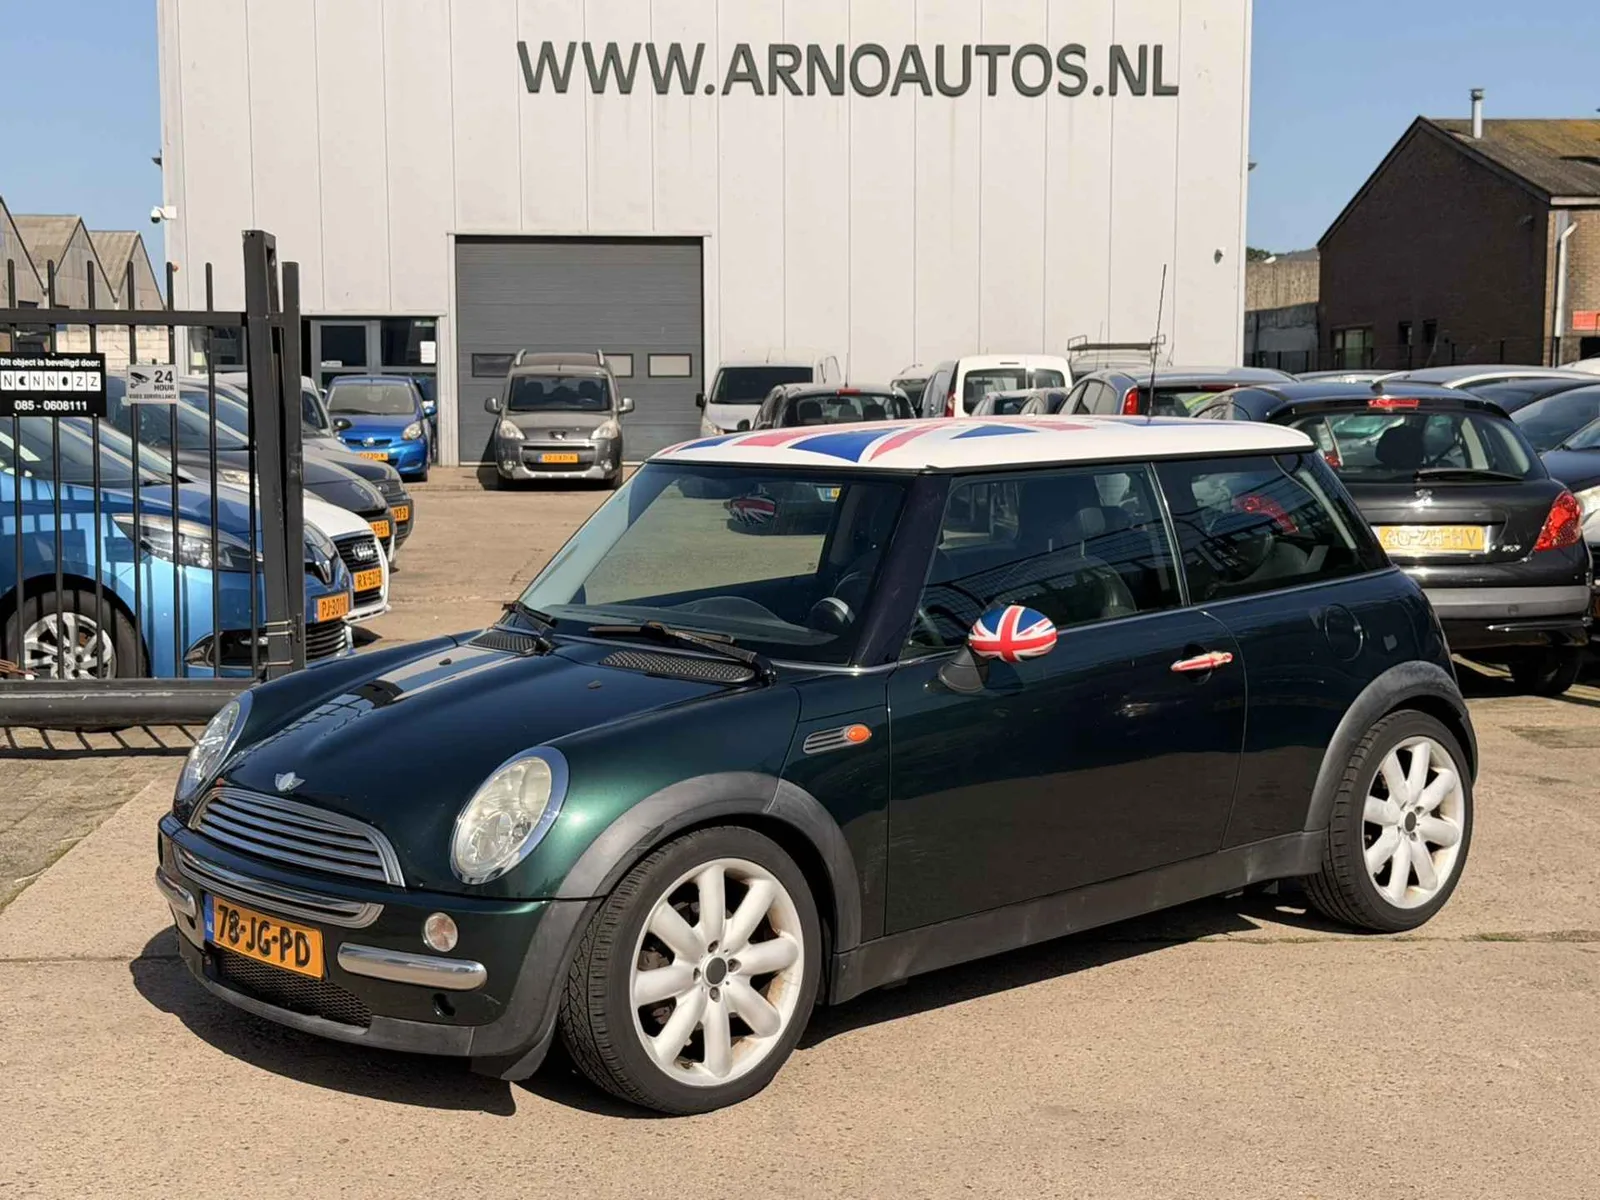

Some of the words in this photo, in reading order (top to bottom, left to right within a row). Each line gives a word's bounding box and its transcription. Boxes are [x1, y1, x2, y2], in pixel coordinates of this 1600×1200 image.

[516, 41, 1179, 97] WWW.ARNOAUTOS.NL
[13, 359, 36, 368] object
[38, 359, 44, 367] is
[46, 359, 79, 369] beveiligd
[154, 370, 173, 383] 24
[14, 400, 35, 411] 085
[43, 400, 87, 411] 0608111
[218, 904, 311, 968] 78-JG-PD
